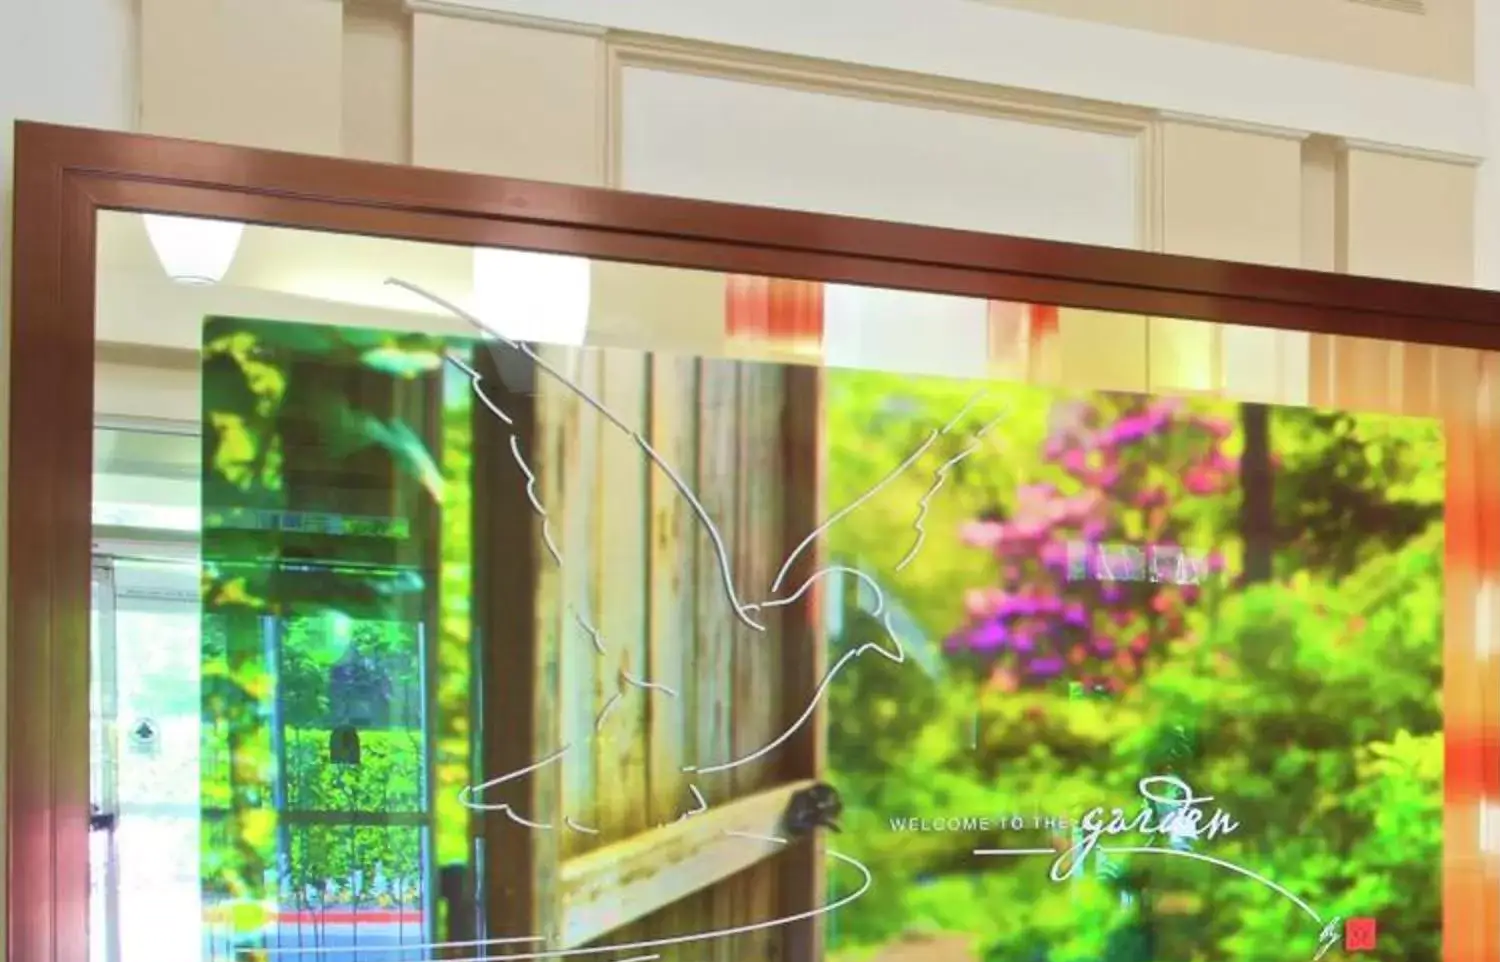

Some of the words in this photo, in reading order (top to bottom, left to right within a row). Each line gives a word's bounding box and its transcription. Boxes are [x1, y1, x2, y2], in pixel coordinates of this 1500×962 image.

[889, 816, 990, 832] WELCOME
[1000, 816, 1024, 831] TO
[1033, 815, 1069, 829] THE
[1050, 776, 1239, 881] garden
